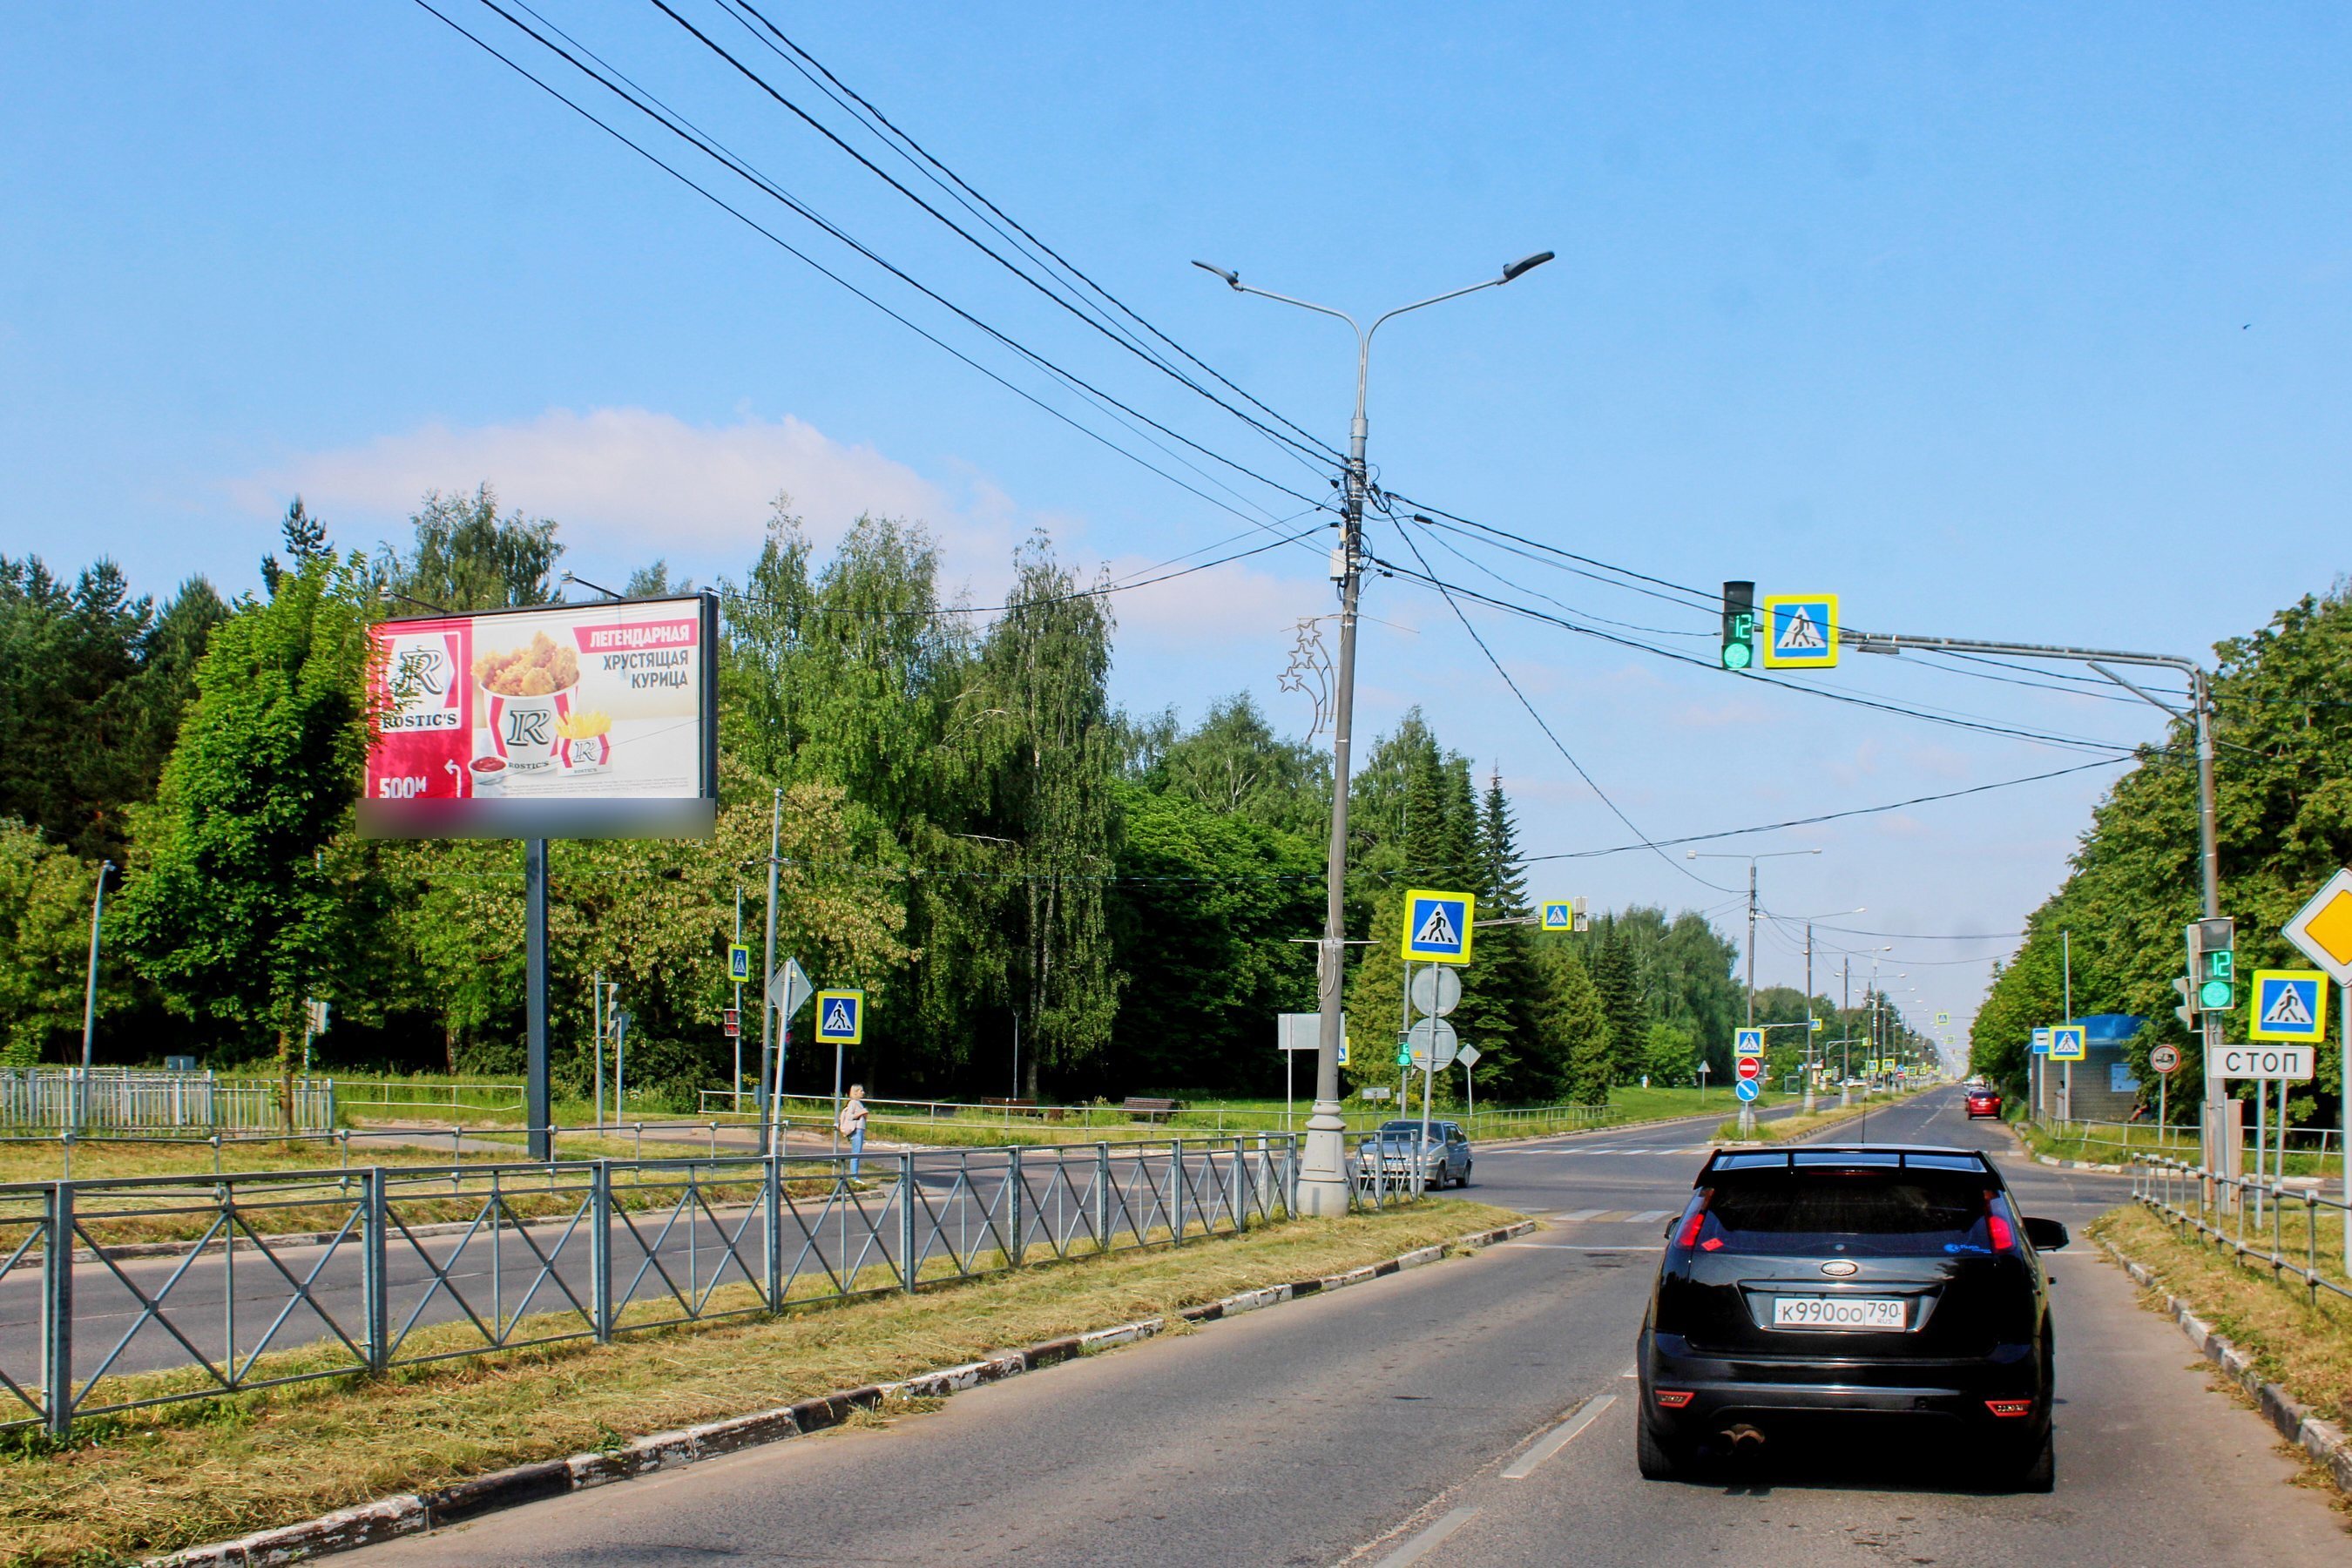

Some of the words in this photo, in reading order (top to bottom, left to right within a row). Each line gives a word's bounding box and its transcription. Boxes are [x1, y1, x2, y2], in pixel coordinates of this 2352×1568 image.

[590, 624, 690, 648] ЛЕГЕНДАРНАЯ
[1735, 614, 1752, 639] 12
[603, 649, 689, 670] ХРУСТЯЩАЯ
[632, 670, 688, 689] КУРИЦА
[382, 713, 457, 728] ROSTIC'S
[2212, 951, 2231, 977] 12
[2226, 1051, 2298, 1073] СТОП
[1867, 1302, 1899, 1318] 790
